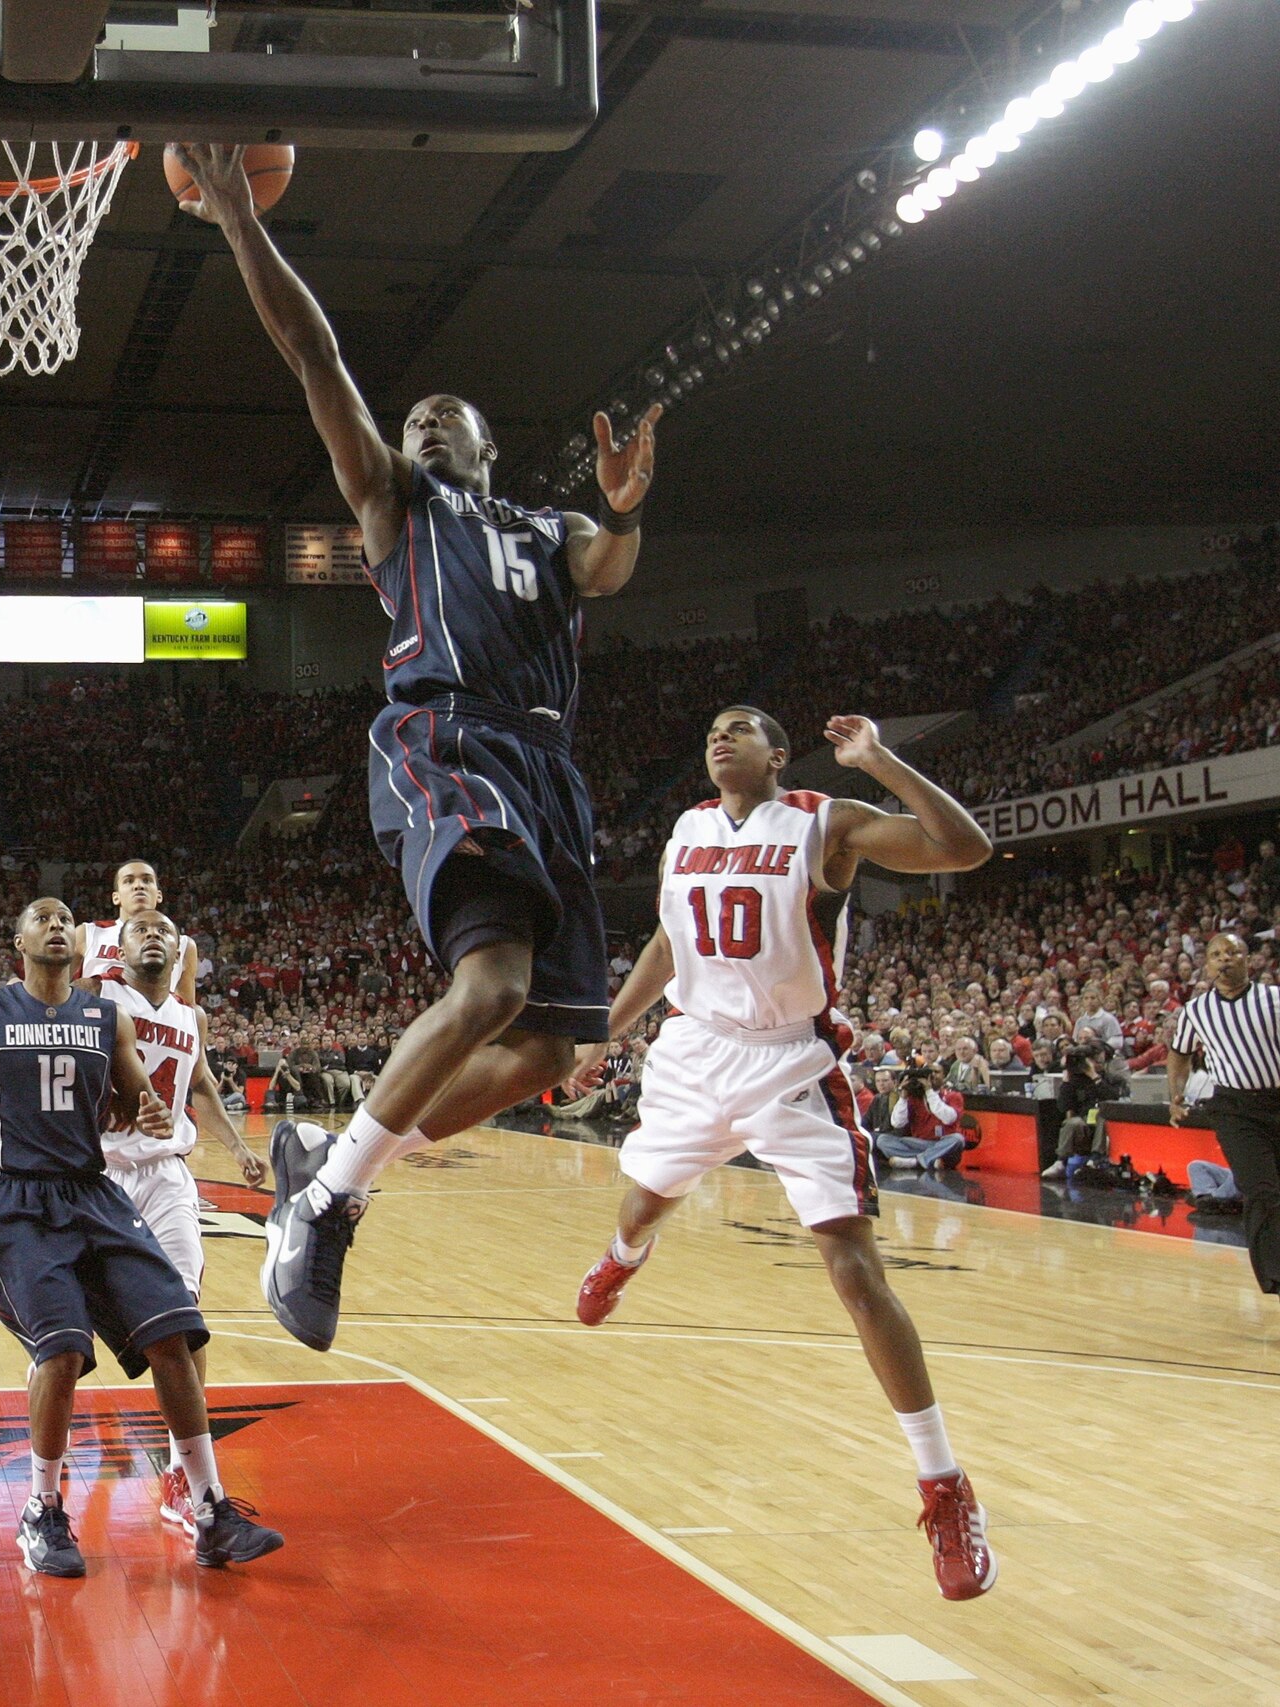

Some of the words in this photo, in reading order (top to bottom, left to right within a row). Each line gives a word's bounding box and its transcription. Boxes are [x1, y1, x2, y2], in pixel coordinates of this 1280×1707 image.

[482, 524, 539, 601] 15
[675, 608, 706, 625] 305
[152, 634, 188, 643] KENTUCKY
[192, 634, 210, 643] FARM
[213, 634, 240, 643] BUREAU
[390, 635, 418, 656] UCONN
[294, 664, 319, 679] 303
[1120, 766, 1228, 817] HALL
[673, 845, 797, 875] LOUISVILLE
[688, 886, 762, 959] 10
[5, 1024, 101, 1048] CONNECTICUT
[133, 1016, 195, 1056] UISVILLE
[38, 1054, 76, 1112] 12
